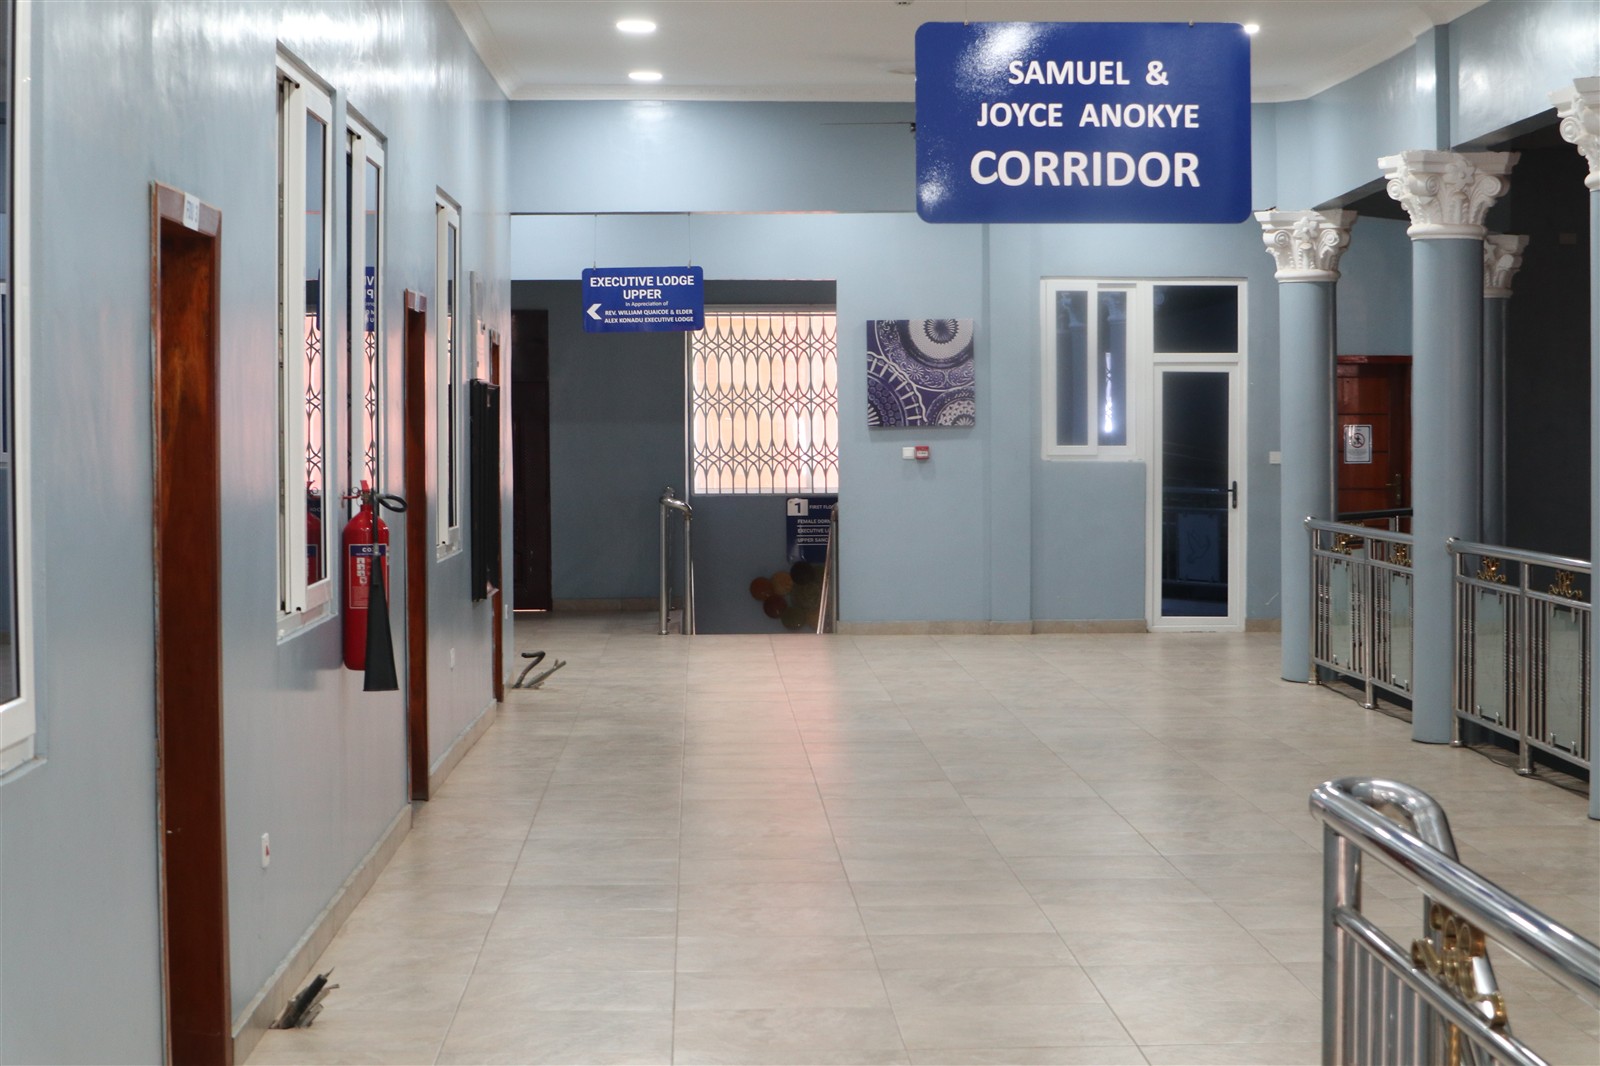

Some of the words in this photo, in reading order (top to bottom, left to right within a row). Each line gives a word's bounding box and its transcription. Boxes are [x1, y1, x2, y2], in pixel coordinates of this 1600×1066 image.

[1008, 61, 1130, 86] SAMUEL
[1145, 61, 1169, 86] &
[977, 103, 1063, 128] JOYCE
[1078, 103, 1200, 129] ANOKYE
[970, 150, 1201, 188] CORRIDOR
[590, 276, 654, 287] EXECUTIVE
[656, 275, 694, 286] LODGE
[623, 289, 662, 299] UPPER
[794, 502, 801, 514] 1
